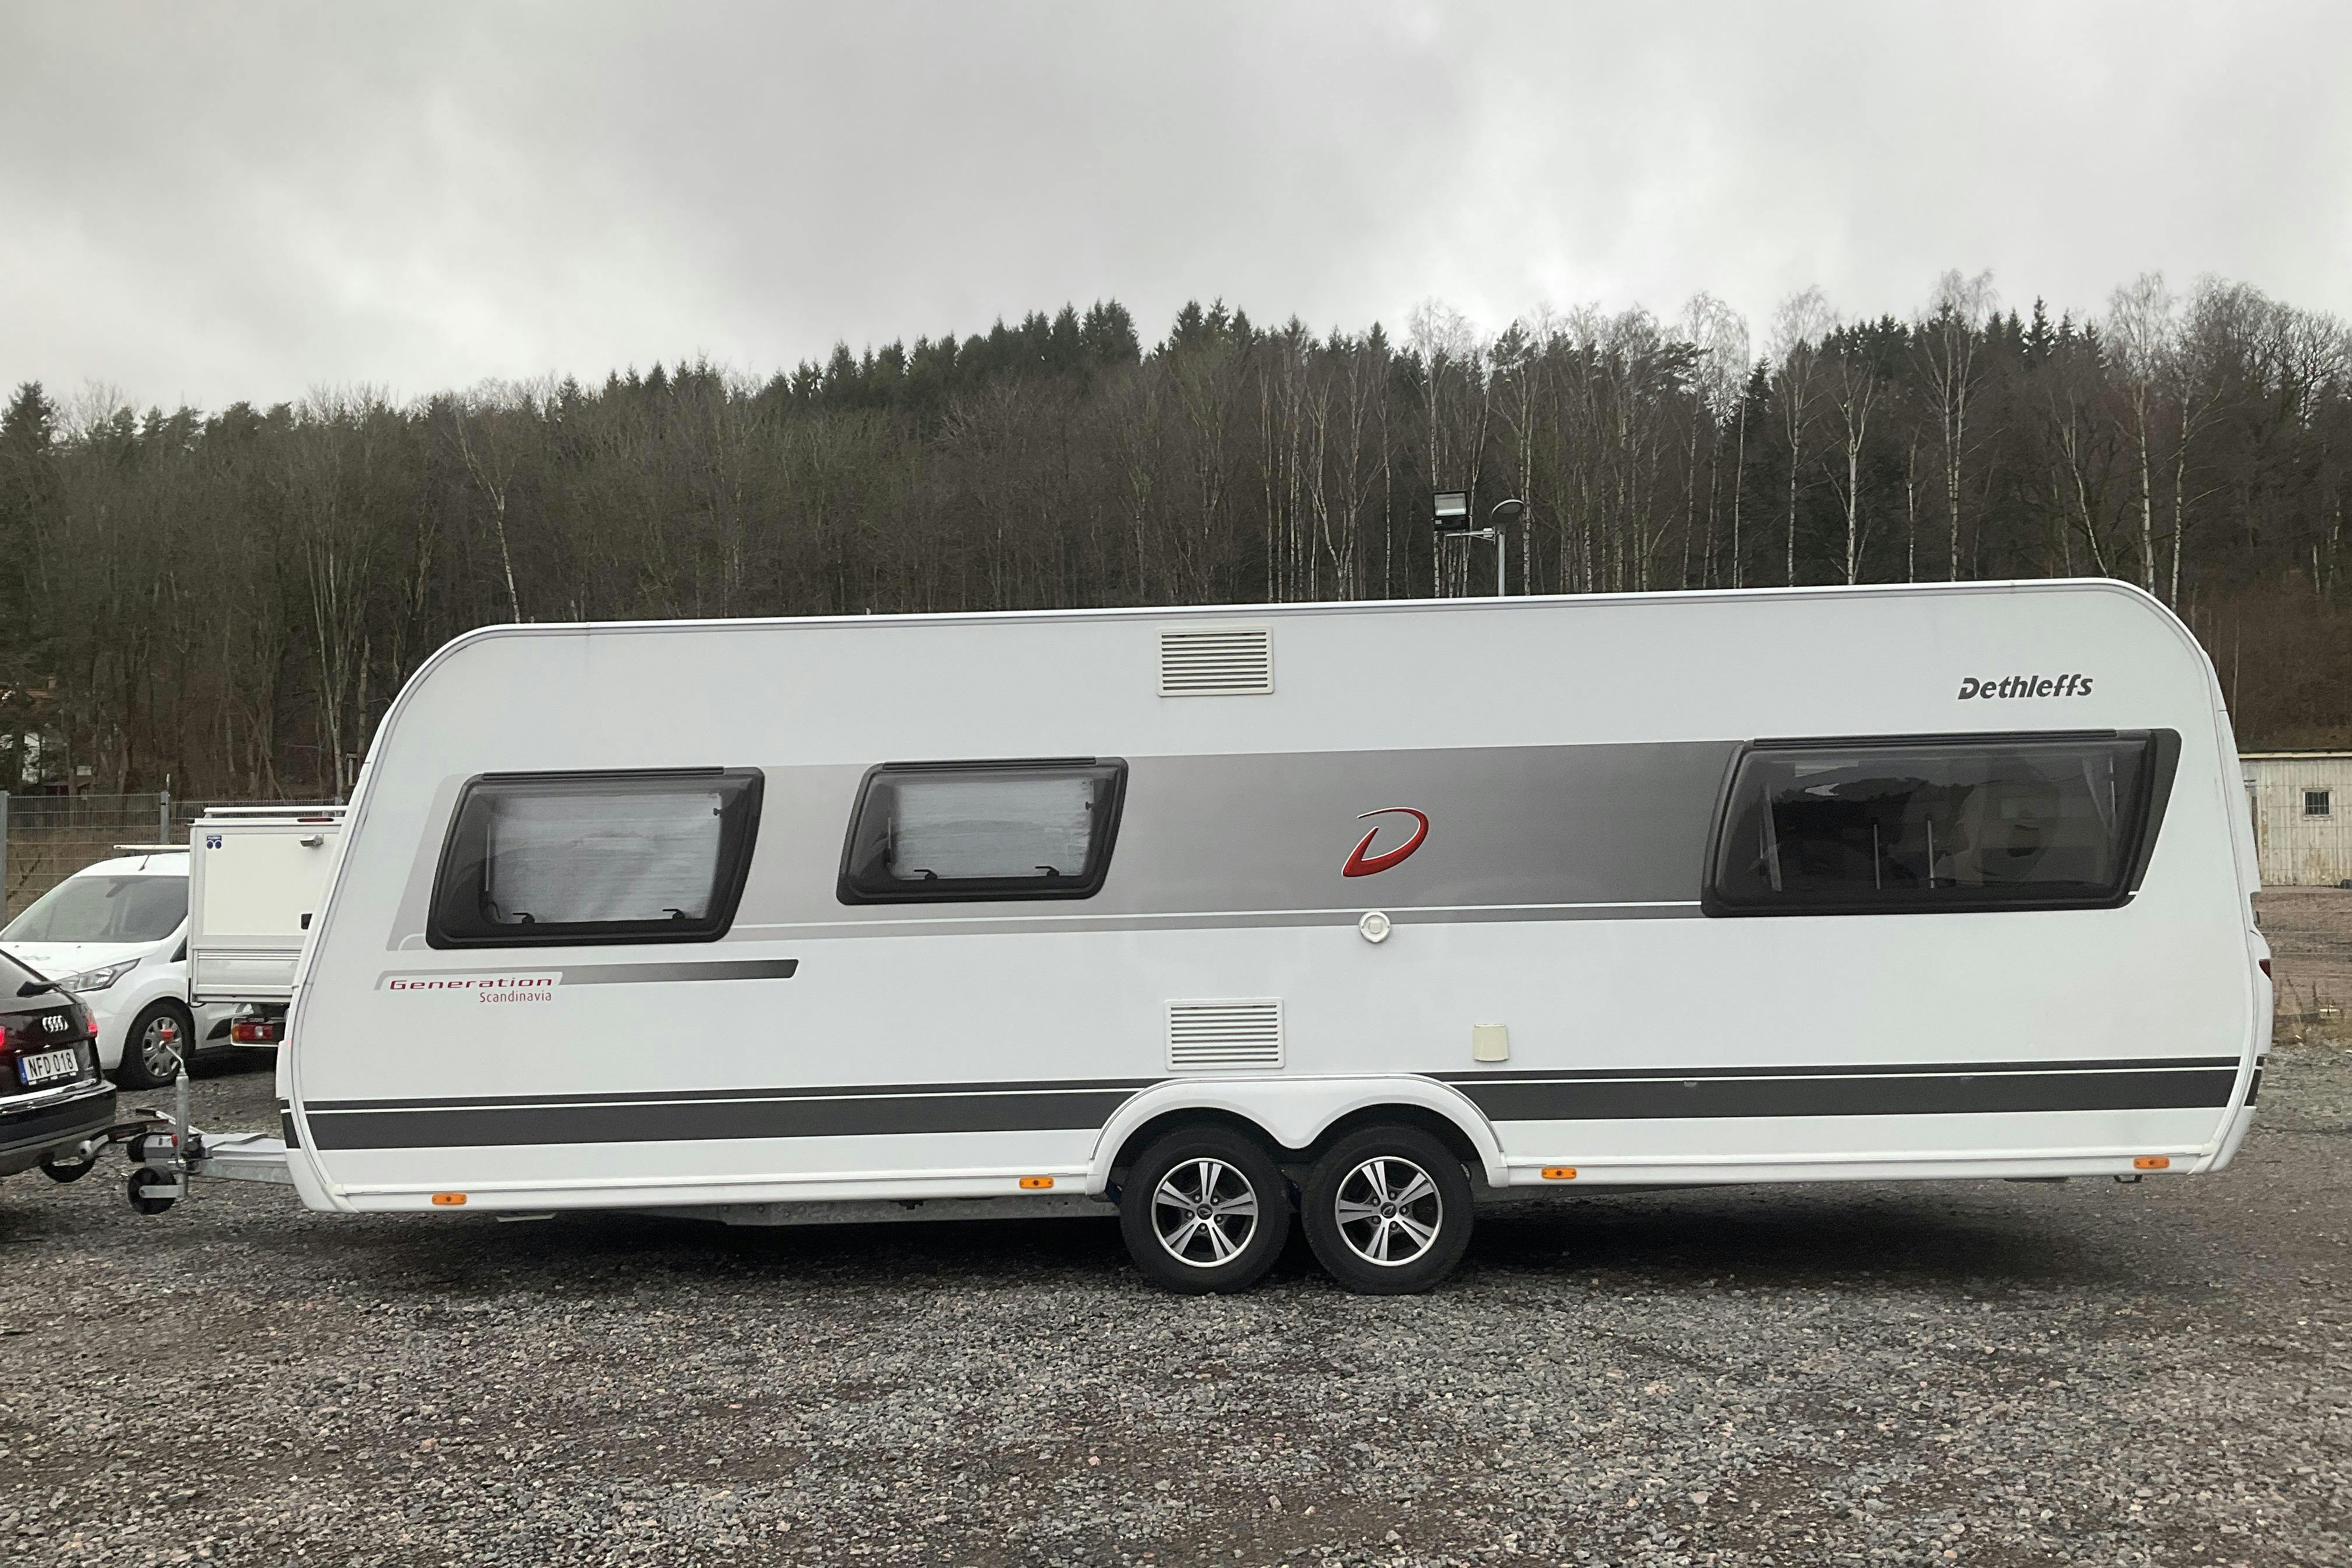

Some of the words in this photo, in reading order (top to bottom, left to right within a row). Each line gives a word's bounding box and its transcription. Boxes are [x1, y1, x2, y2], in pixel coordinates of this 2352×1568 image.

[1958, 674, 2093, 699] Dethleffs
[390, 977, 552, 990] Generation
[480, 990, 552, 1003] Scandinavia
[28, 1056, 51, 1077] NFD
[53, 1052, 73, 1072] 018
